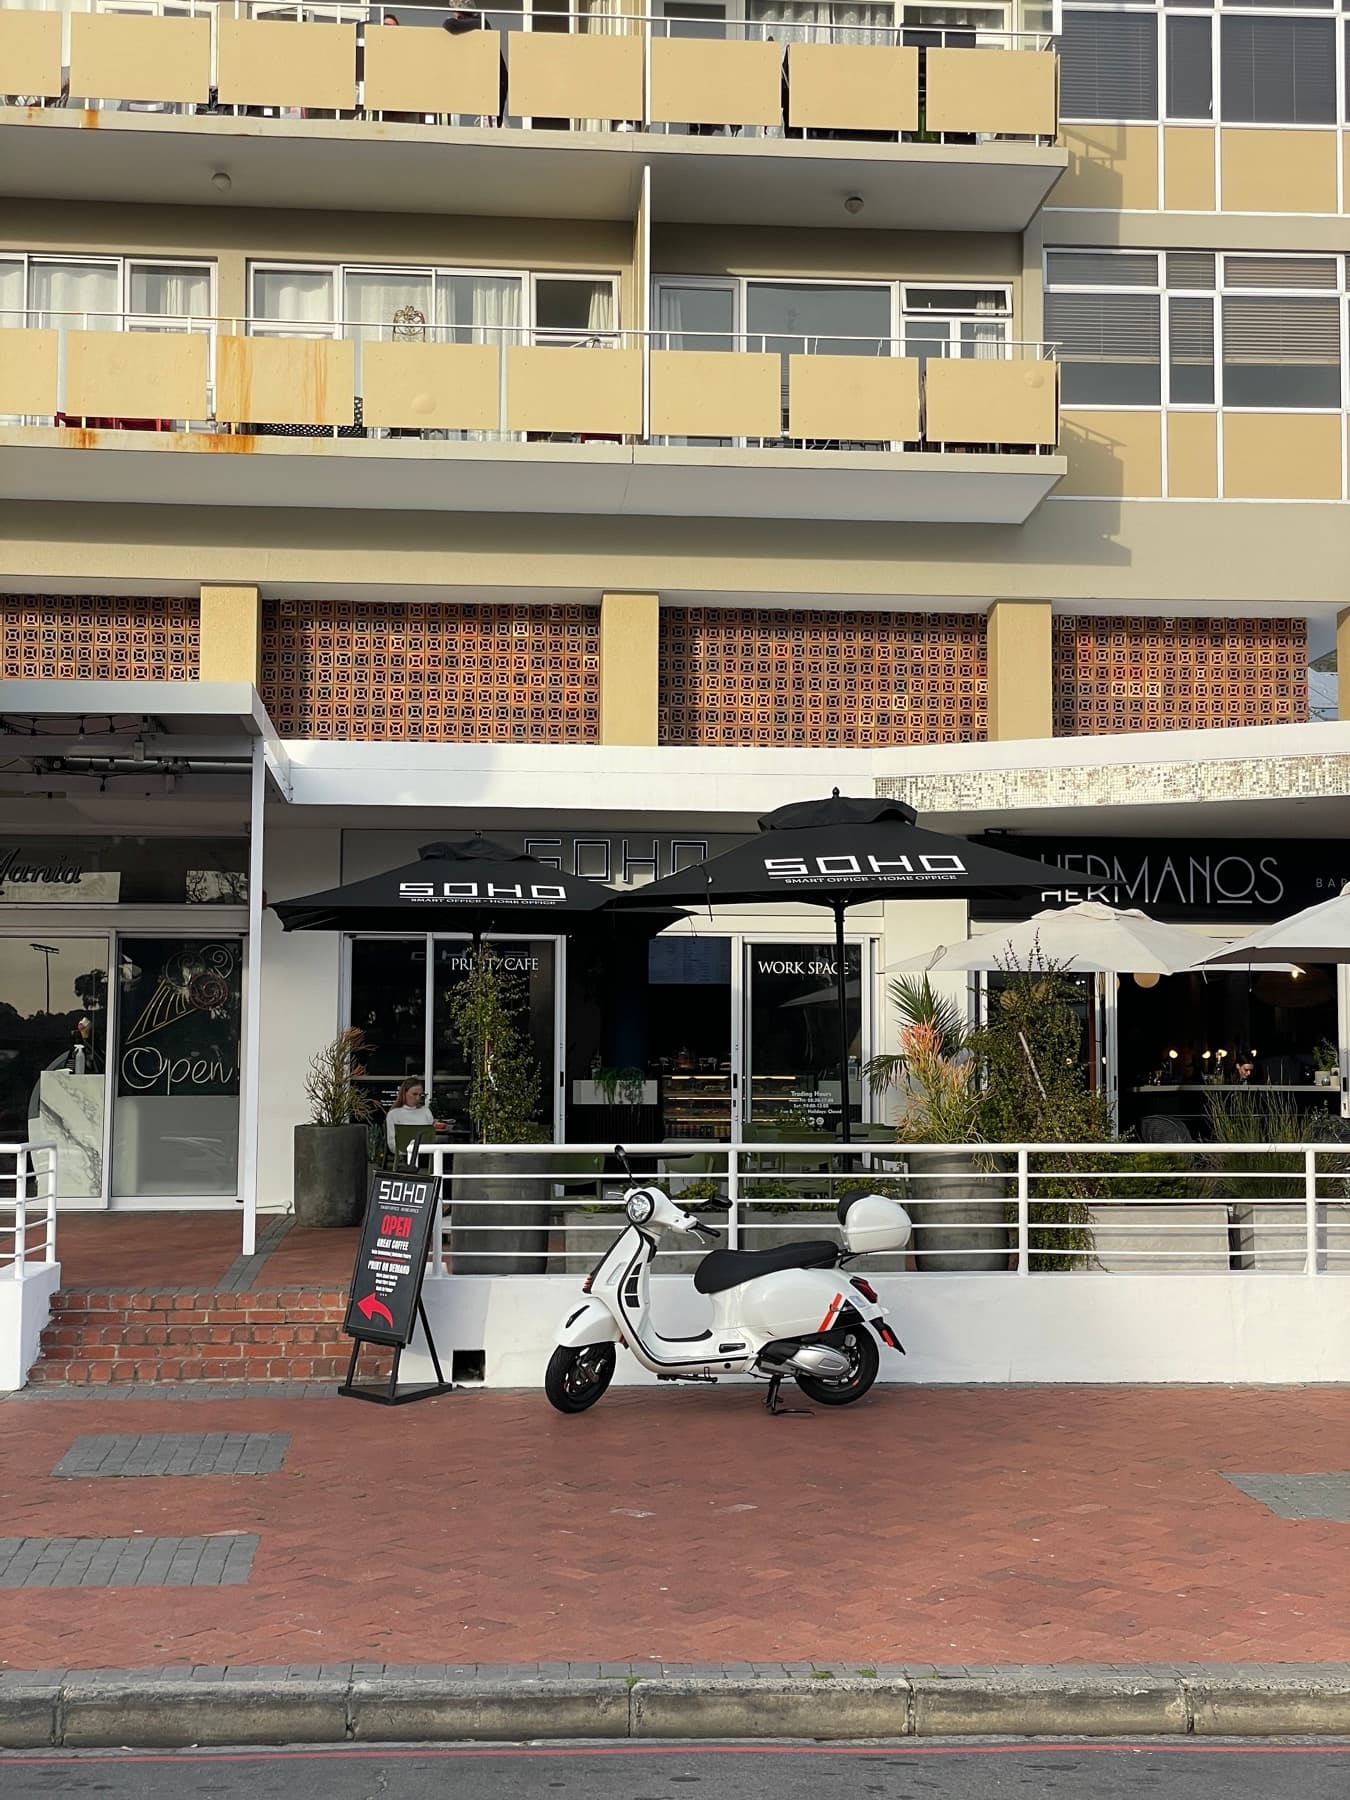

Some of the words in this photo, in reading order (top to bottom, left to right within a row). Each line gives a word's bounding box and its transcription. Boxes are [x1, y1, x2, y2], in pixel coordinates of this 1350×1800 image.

[524, 839, 708, 882] SOHO
[764, 855, 966, 875] SOHO
[1041, 854, 1284, 903] HERMANOS
[399, 882, 567, 899] SOHO
[758, 961, 804, 975] WORK
[378, 1180, 427, 1204] SOHO
[380, 1214, 412, 1238] OPEN
[376, 1238, 392, 1249] GREAT
[391, 1239, 409, 1251] COFFEE
[367, 1260, 382, 1271] PRINT
[389, 1263, 410, 1275] DEMAND
